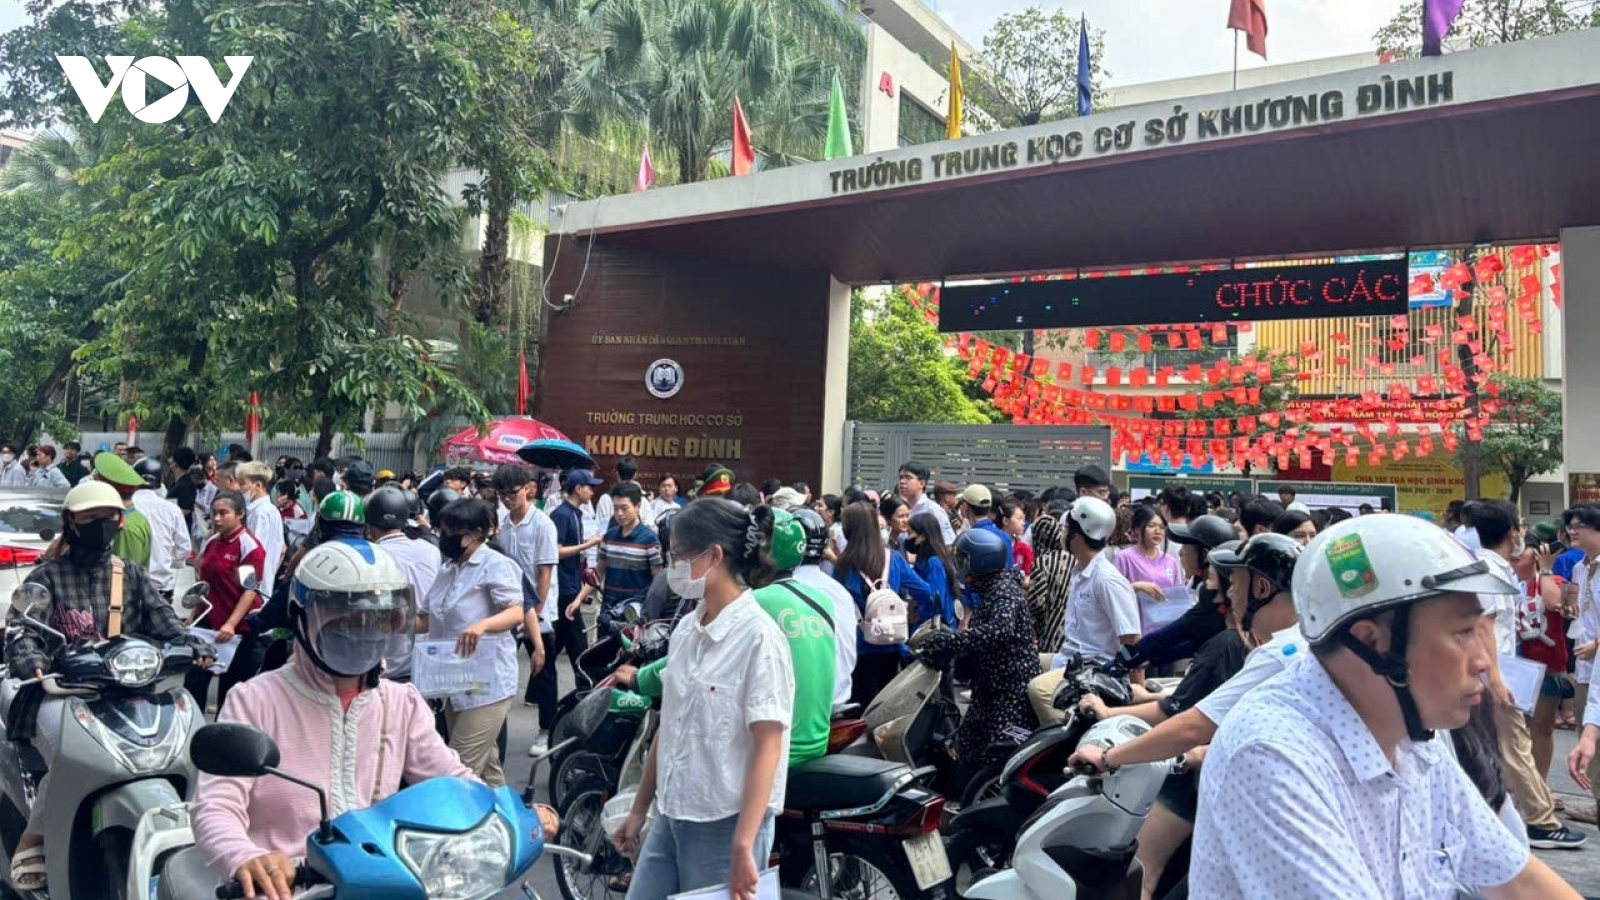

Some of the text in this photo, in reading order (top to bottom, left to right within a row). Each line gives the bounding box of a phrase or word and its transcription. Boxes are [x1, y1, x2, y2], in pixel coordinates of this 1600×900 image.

[879, 71, 894, 98] A
[830, 71, 1454, 193] TRƯỜNG TRUNG HỌC CƠ SỞ KHƯƠNG ĐÌNH
[1215, 269, 1399, 308] CHÚC CÁC
[587, 408, 635, 424] TRƯỜNG
[639, 413, 677, 425] TRUNG
[585, 433, 741, 459] KHƯƠNG ĐÌNH
